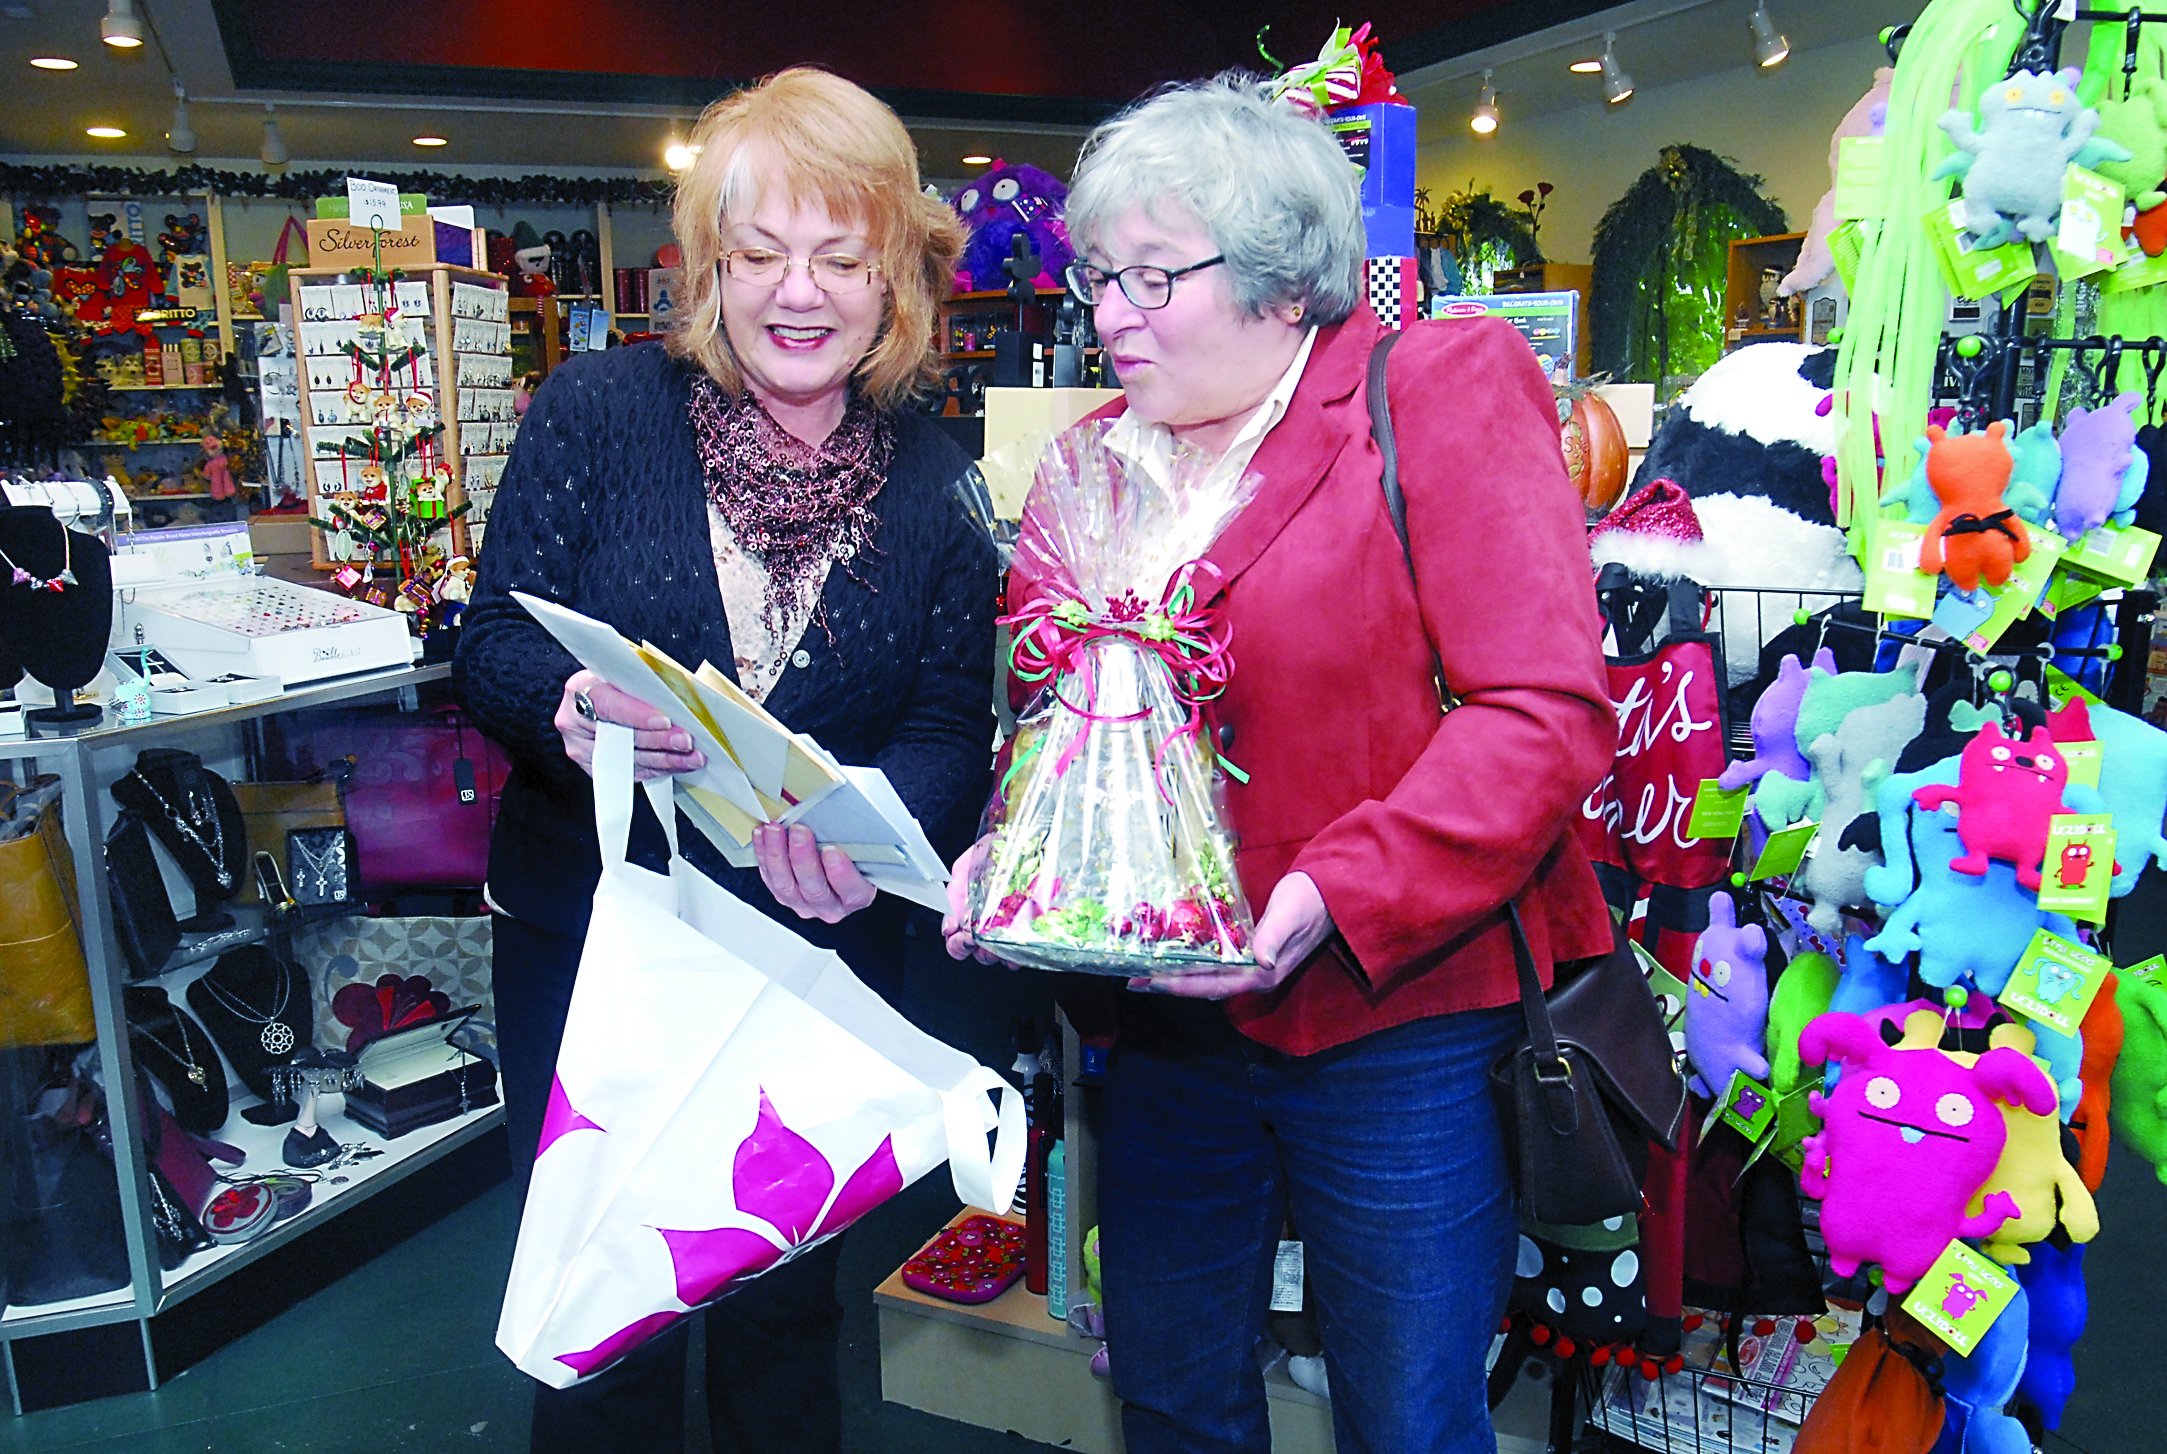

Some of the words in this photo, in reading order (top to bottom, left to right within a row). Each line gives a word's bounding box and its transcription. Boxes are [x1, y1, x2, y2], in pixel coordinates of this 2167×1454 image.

[349, 179, 366, 192] BOO
[319, 228, 371, 252] Silver
[2052, 823, 2106, 836] UGLYDOLL
[2043, 935, 2069, 954] LITTLE
[2010, 991, 2070, 1028] UGLYDOLL
[1954, 1251, 1981, 1272] LITTLE
[1913, 1301, 1967, 1347] UGLYDOLL
